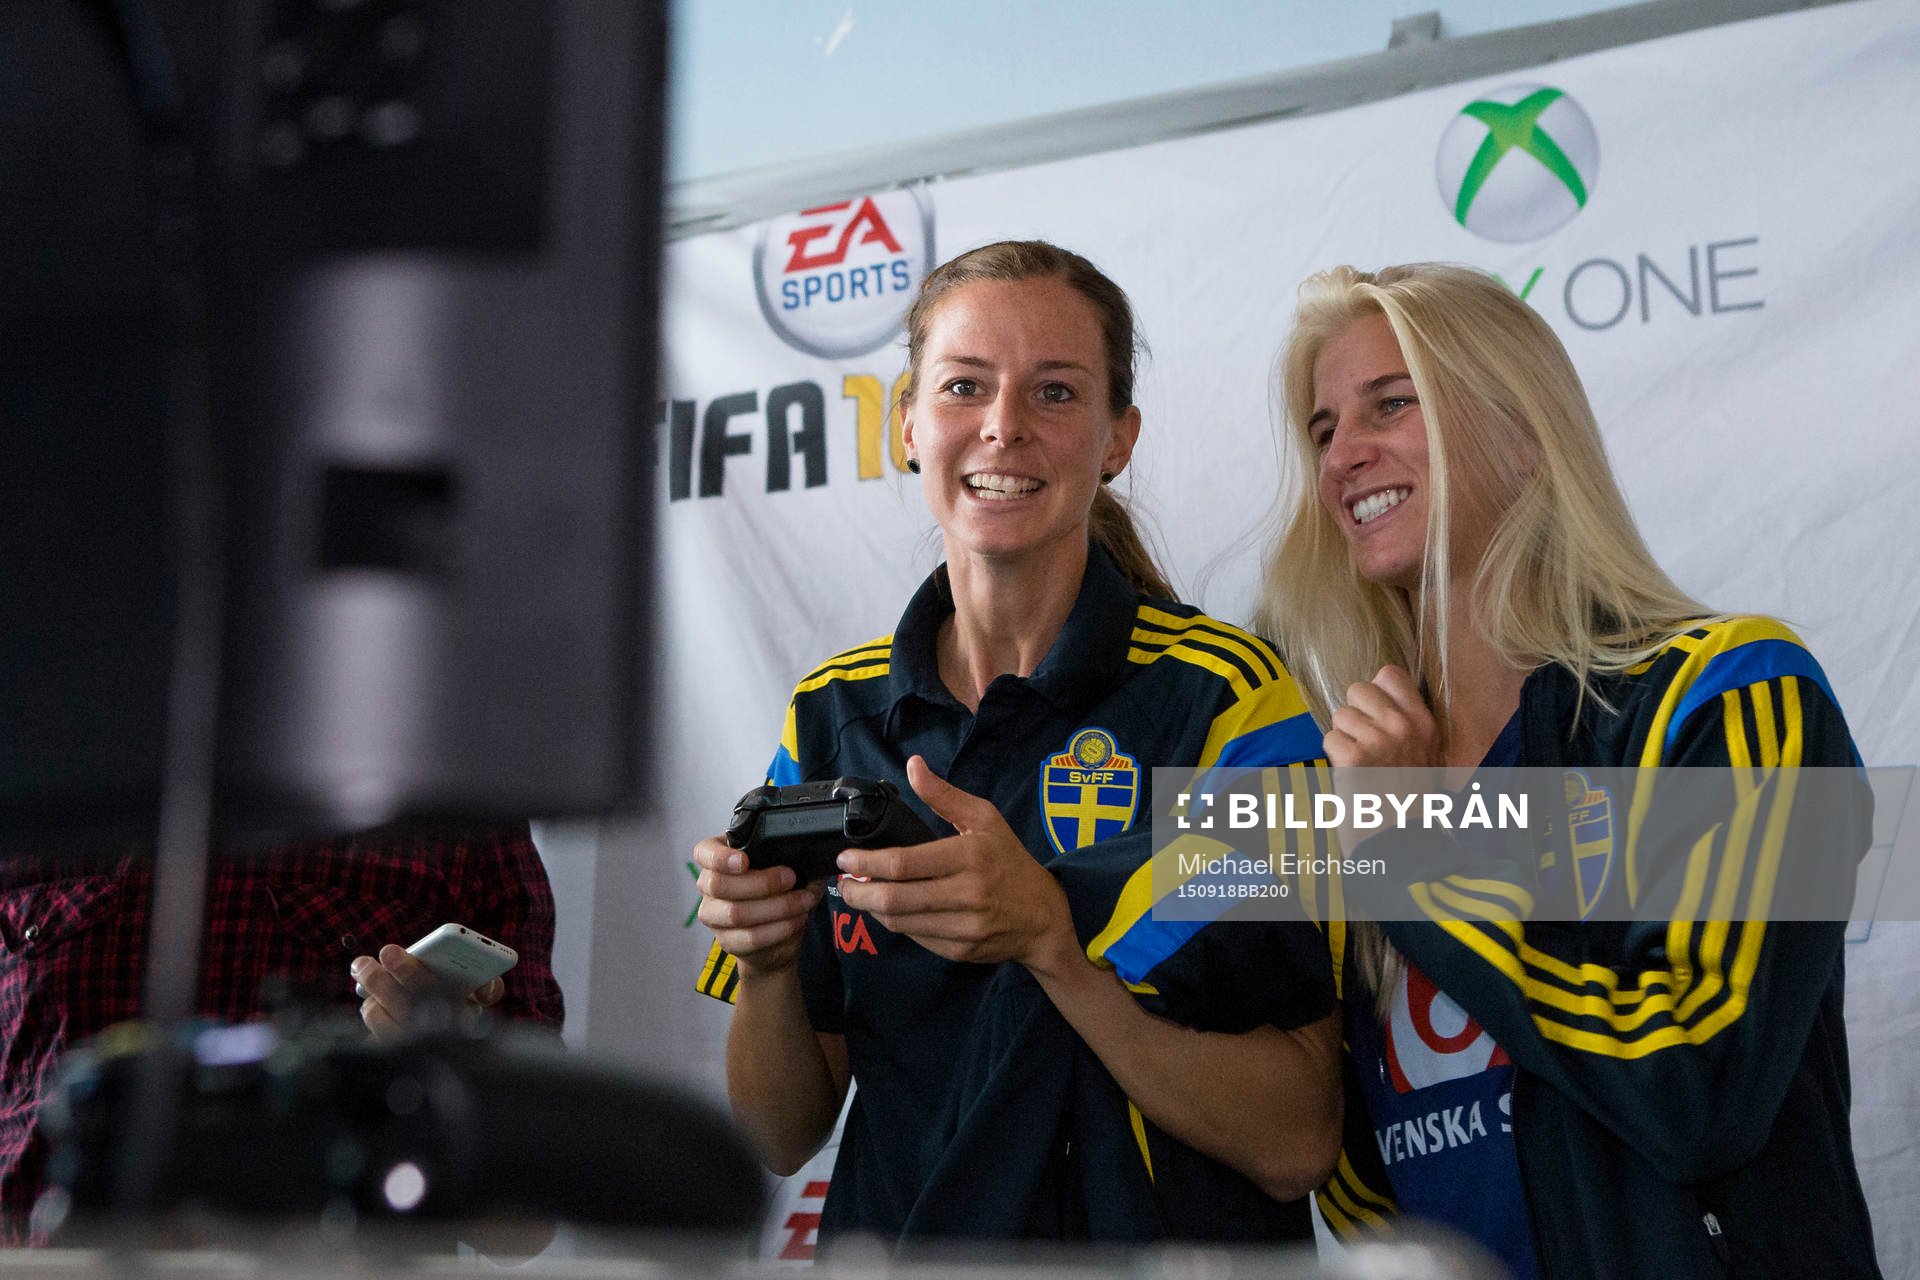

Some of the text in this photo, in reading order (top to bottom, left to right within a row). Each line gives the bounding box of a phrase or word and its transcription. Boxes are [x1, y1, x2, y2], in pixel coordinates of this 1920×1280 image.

[783, 196, 904, 273] EA
[782, 260, 911, 311] SPORTS
[1563, 236, 1766, 331] ONE
[655, 380, 828, 503] IFA
[1069, 771, 1114, 784] SvFF
[833, 910, 878, 955] ICA
[1375, 1100, 1488, 1166] VENSKA
